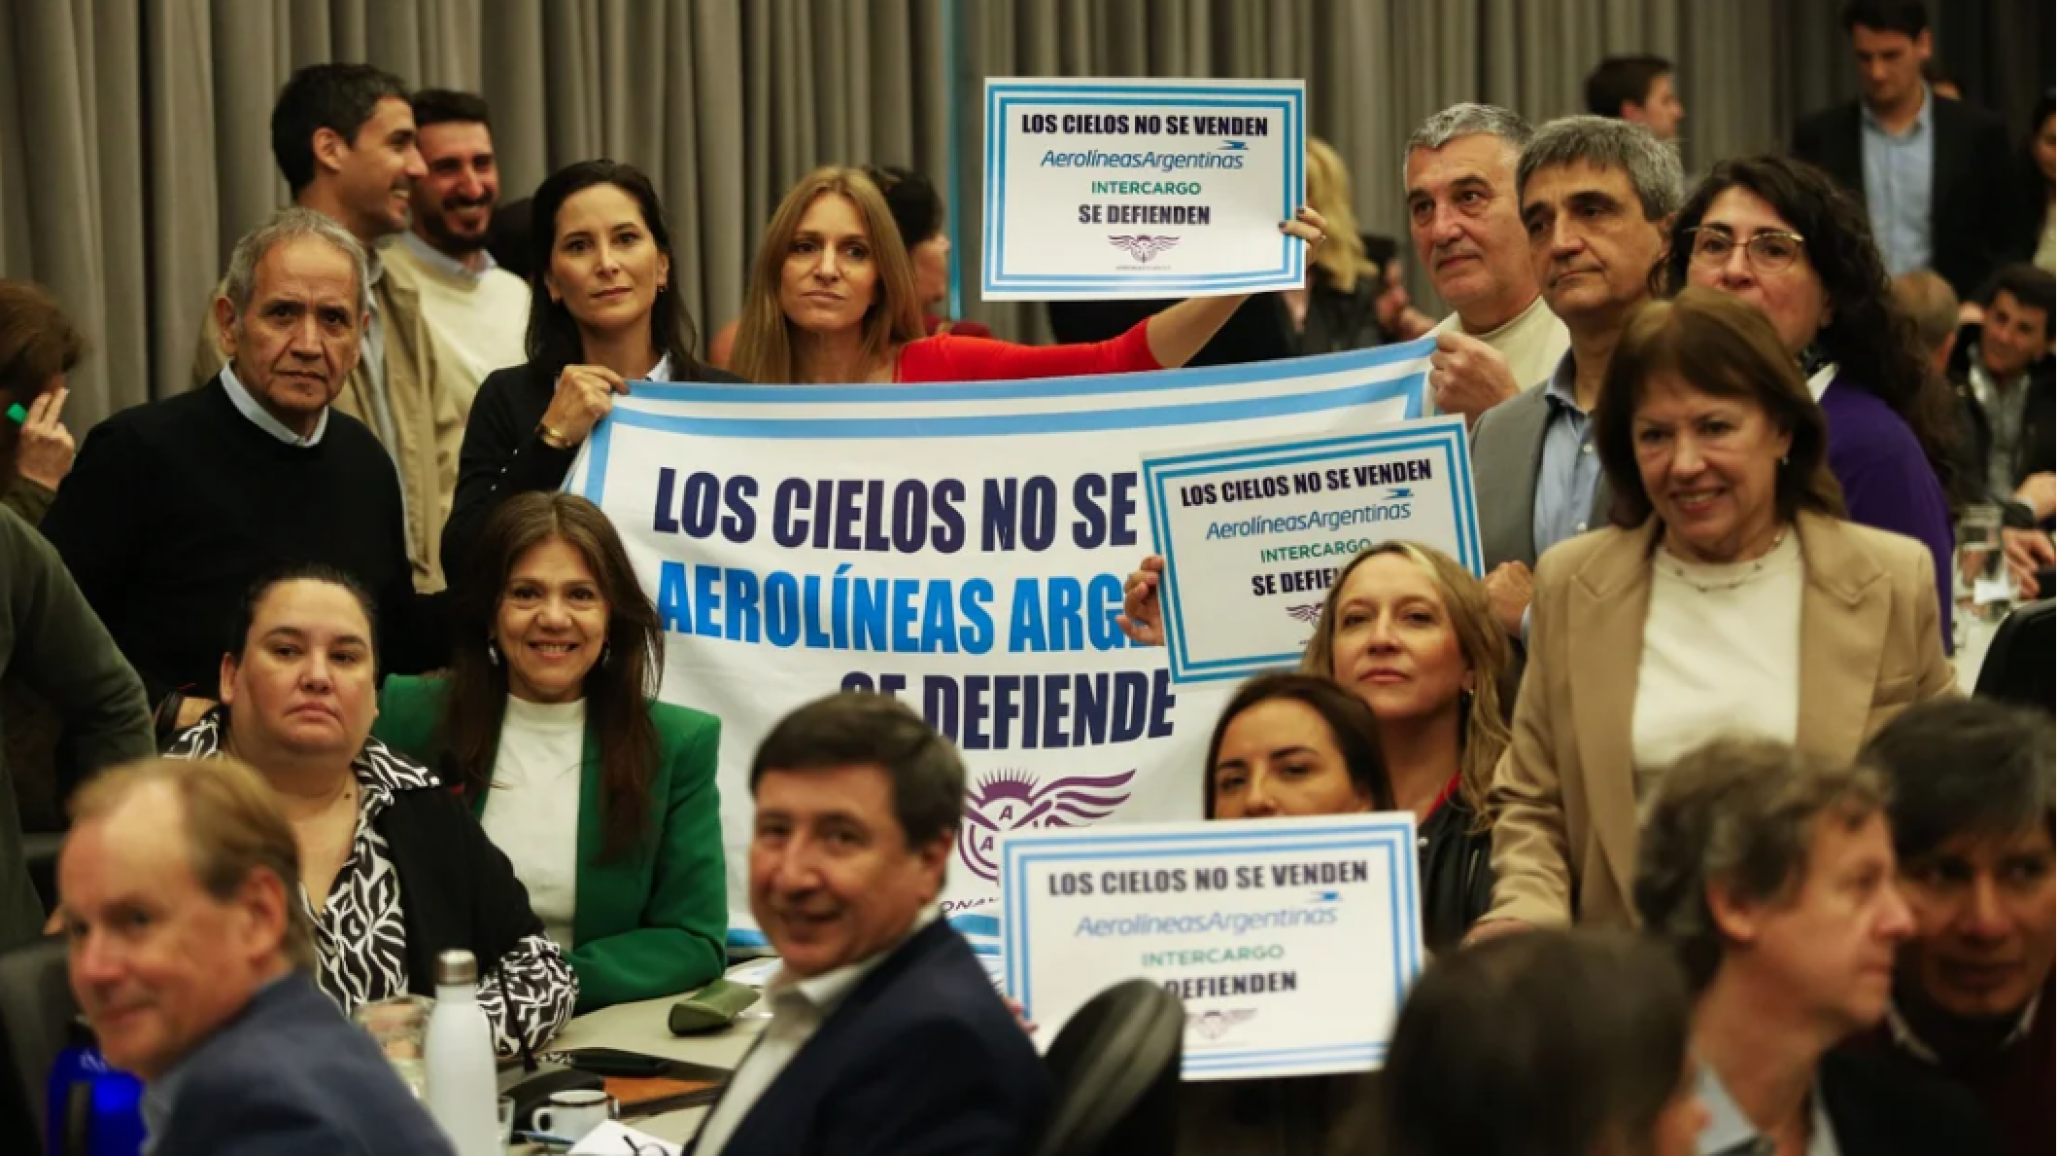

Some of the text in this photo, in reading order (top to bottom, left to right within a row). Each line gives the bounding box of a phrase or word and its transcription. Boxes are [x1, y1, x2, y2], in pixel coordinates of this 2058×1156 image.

[1022, 114, 1267, 137] LOS CIELOS NO SE VENDEN
[1091, 180, 1202, 195] INTERCARGO
[1078, 204, 1210, 225] SE DEFIENDEN
[1181, 458, 1432, 507] LOS CIELOS NO SE VENDEN
[653, 467, 1137, 553] LOS CIELOS NO SE
[1261, 538, 1372, 563] INTERCARGO
[1251, 567, 1339, 596] SE DEFIE
[659, 559, 1164, 655] AEROLÍNEAS ARG
[923, 668, 1176, 750] DEFIENDE
[1048, 860, 1369, 896] LOS CIELOS NO SE VENDEN
[1142, 944, 1286, 968] INTERCARGO
